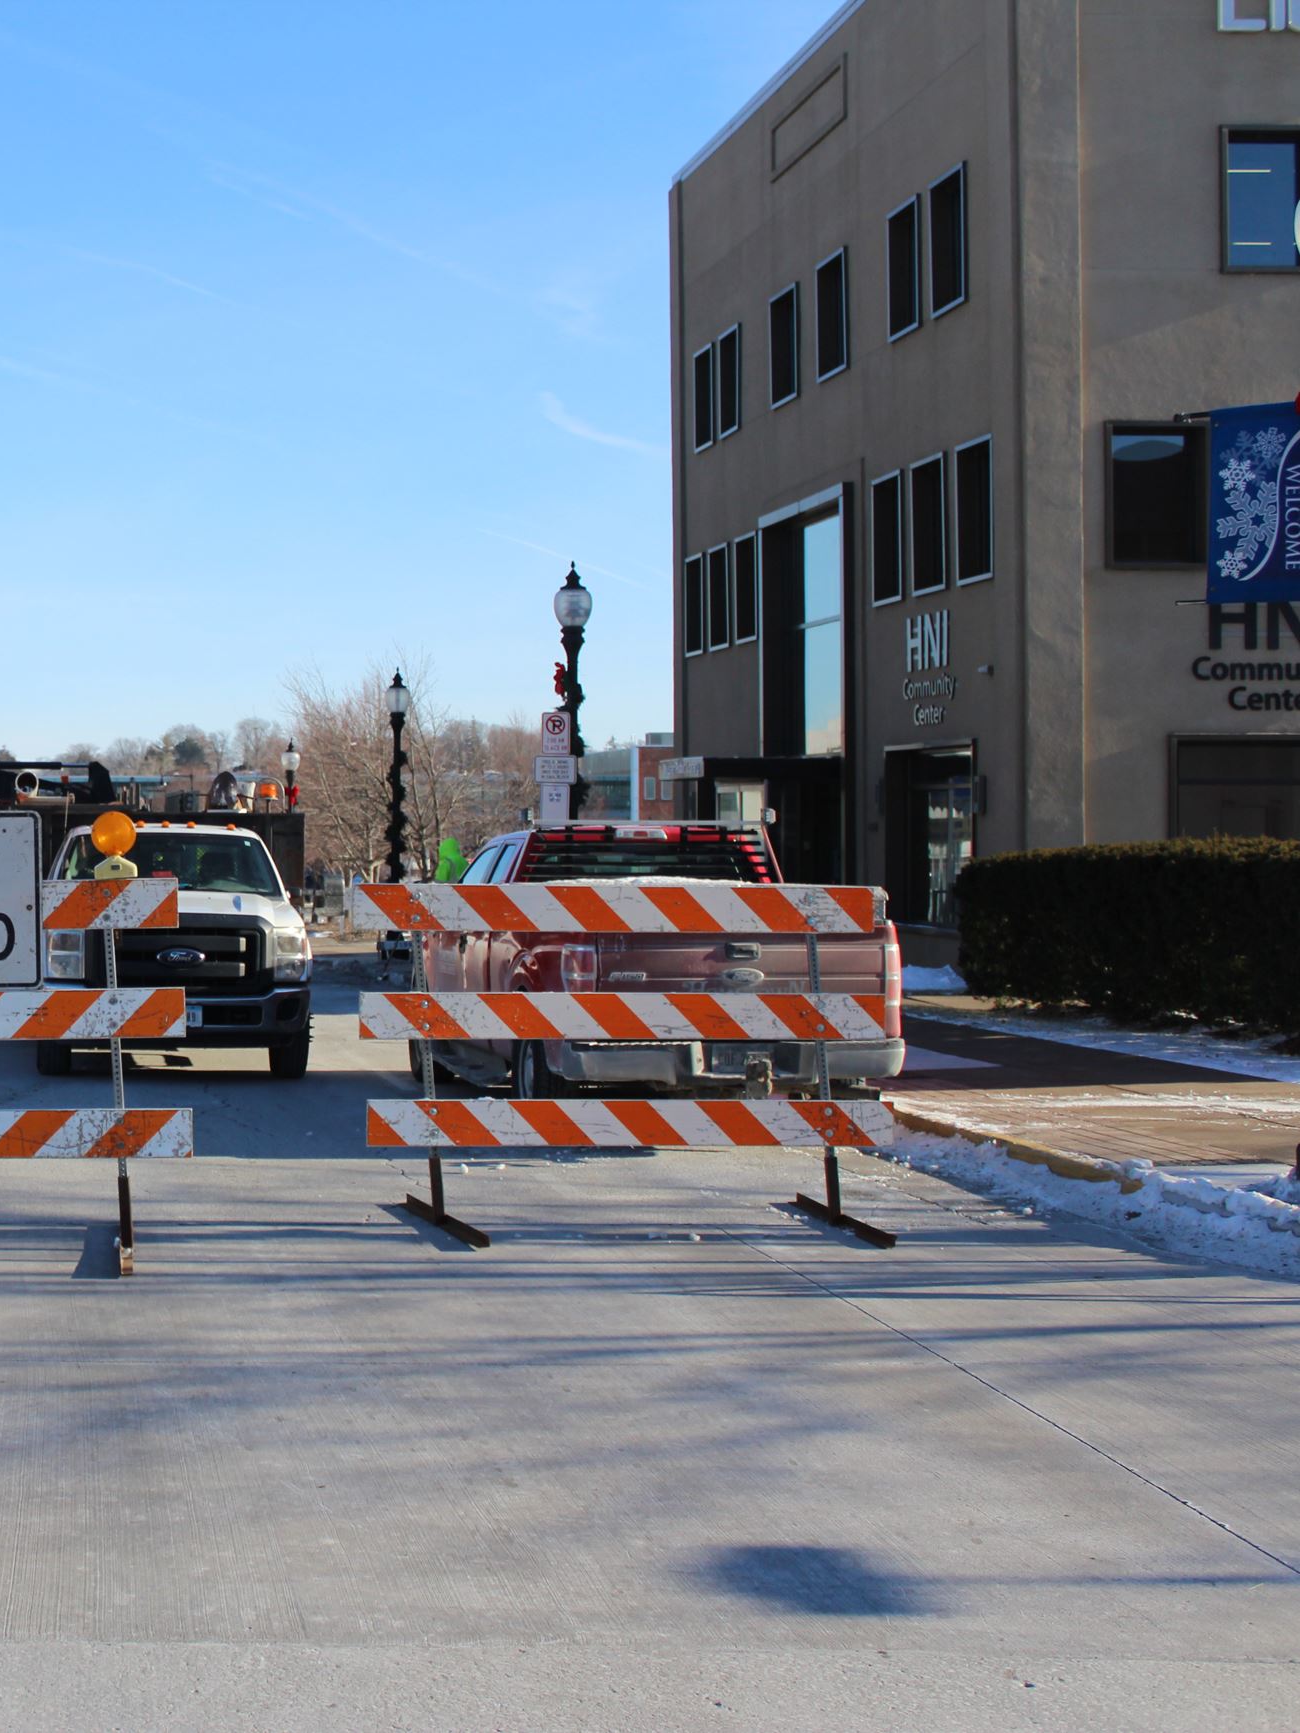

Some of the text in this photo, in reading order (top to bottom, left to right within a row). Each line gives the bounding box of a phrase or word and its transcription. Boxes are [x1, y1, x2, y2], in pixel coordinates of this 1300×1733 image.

[1284, 464, 1300, 570] WELCOME
[905, 609, 950, 673] HNI
[902, 673, 956, 701] Community
[913, 704, 945, 726] Center
